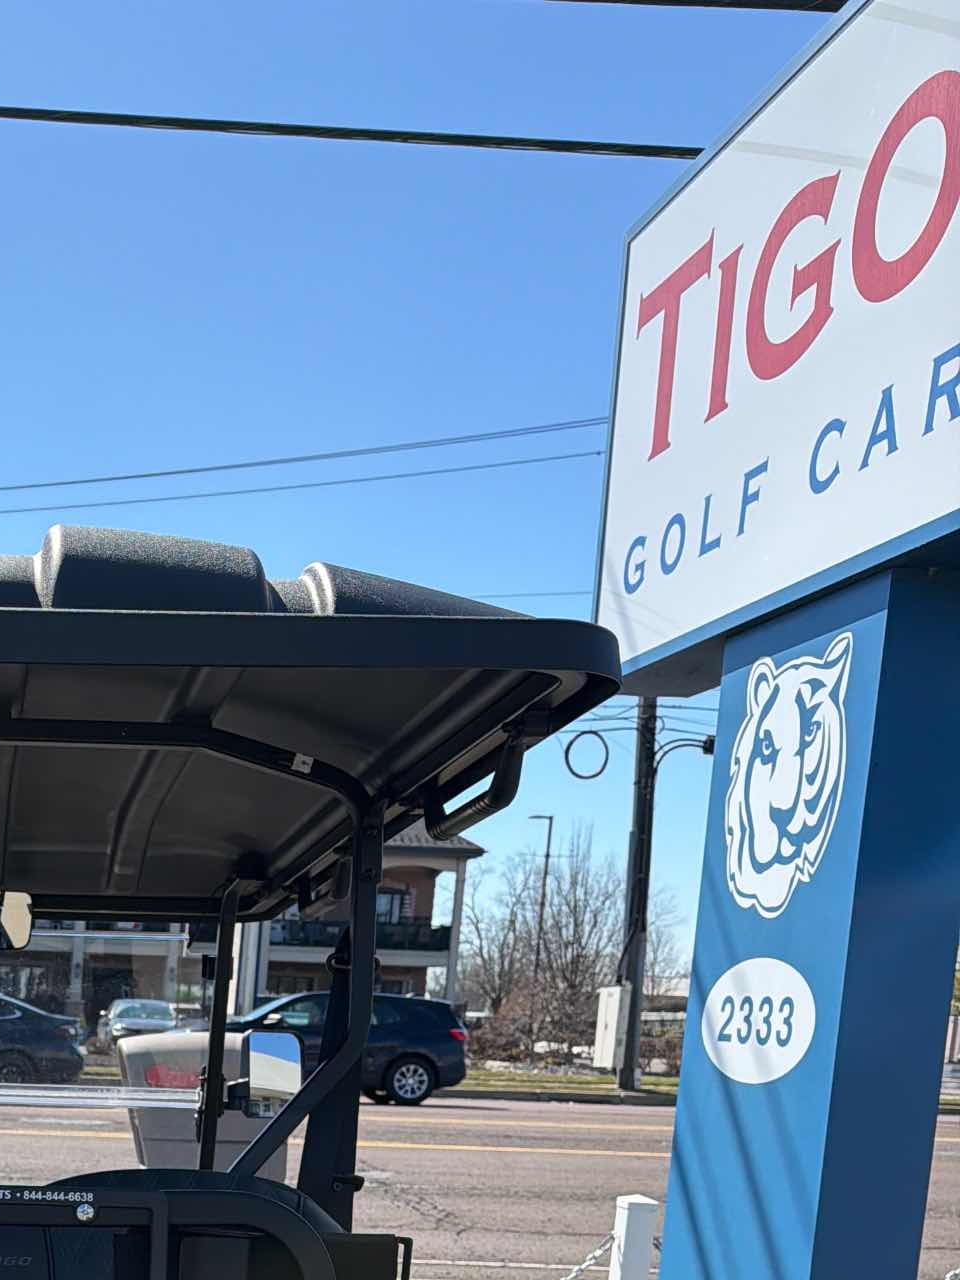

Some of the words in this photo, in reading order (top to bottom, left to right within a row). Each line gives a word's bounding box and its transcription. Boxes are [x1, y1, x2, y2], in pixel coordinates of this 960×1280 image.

[623, 458, 769, 595] GOLF
[717, 996, 795, 1047] 2333
[23, 1190, 94, 1202] 844-844-6638
